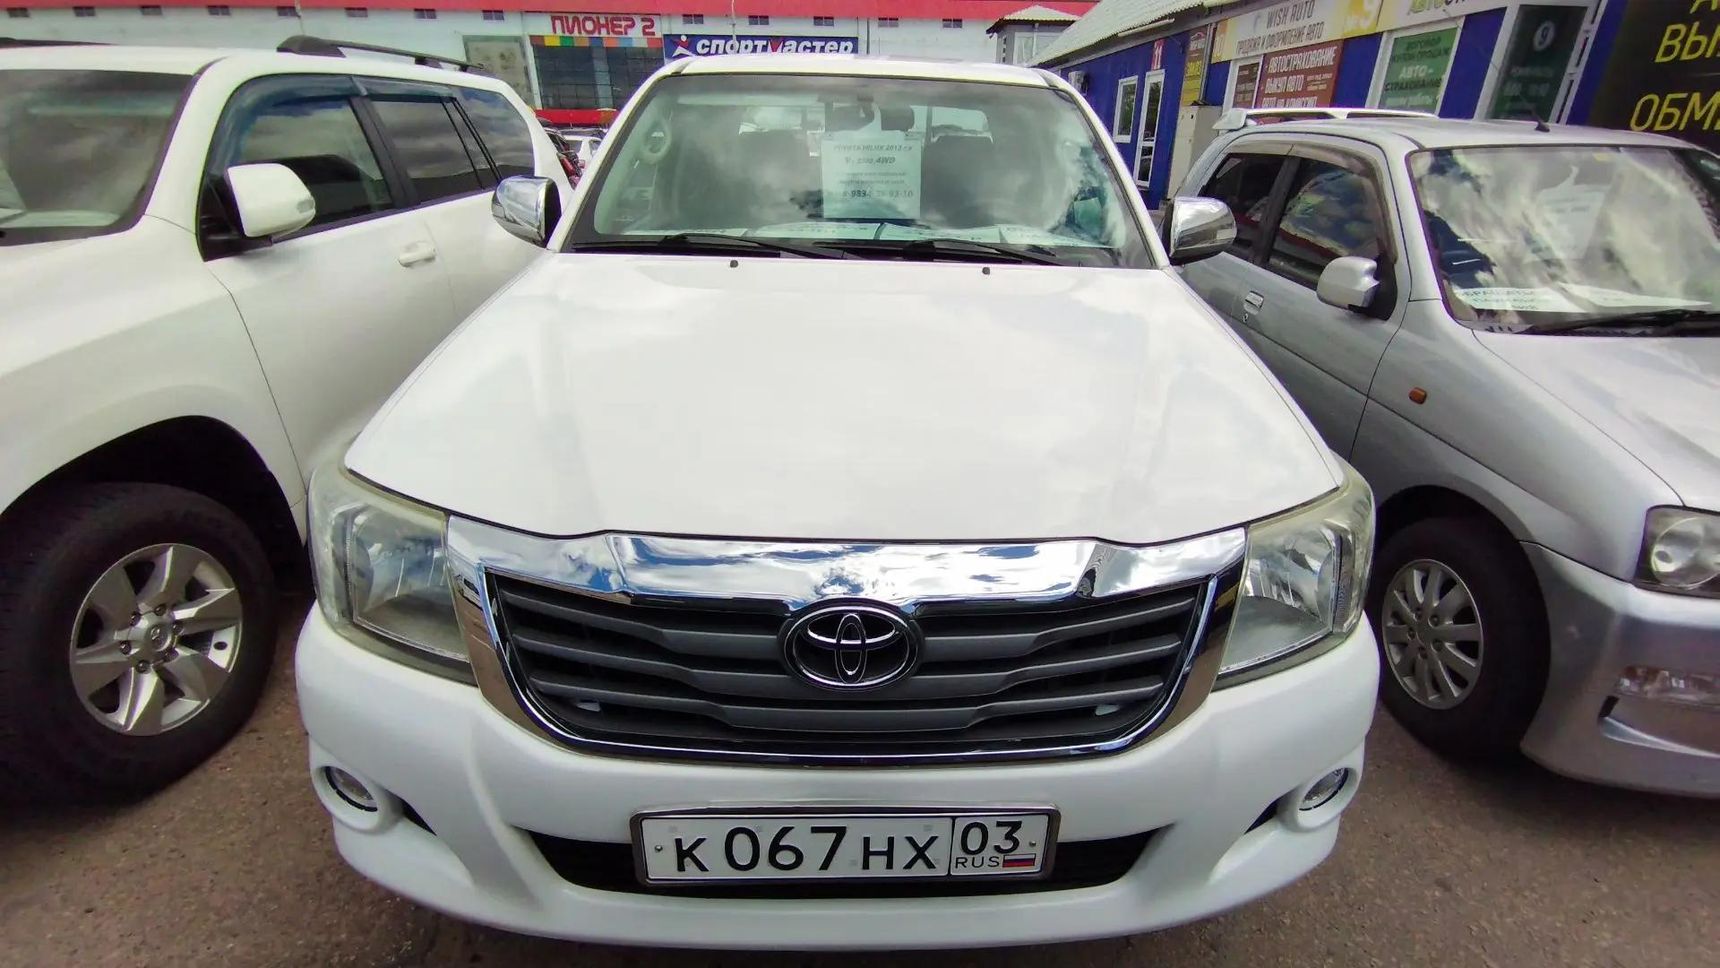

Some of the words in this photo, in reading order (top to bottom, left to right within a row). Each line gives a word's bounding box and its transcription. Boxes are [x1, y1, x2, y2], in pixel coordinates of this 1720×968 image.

[550, 15, 636, 36] ПИОНЕР
[640, 17, 656, 36] 2
[1266, 7, 1290, 29] WISH
[1268, 46, 1337, 73] АВТОСТРАХОВАНИЕ
[1629, 91, 1720, 131] ОБМ
[959, 820, 1023, 856] 03
[955, 855, 1000, 869] RUS
